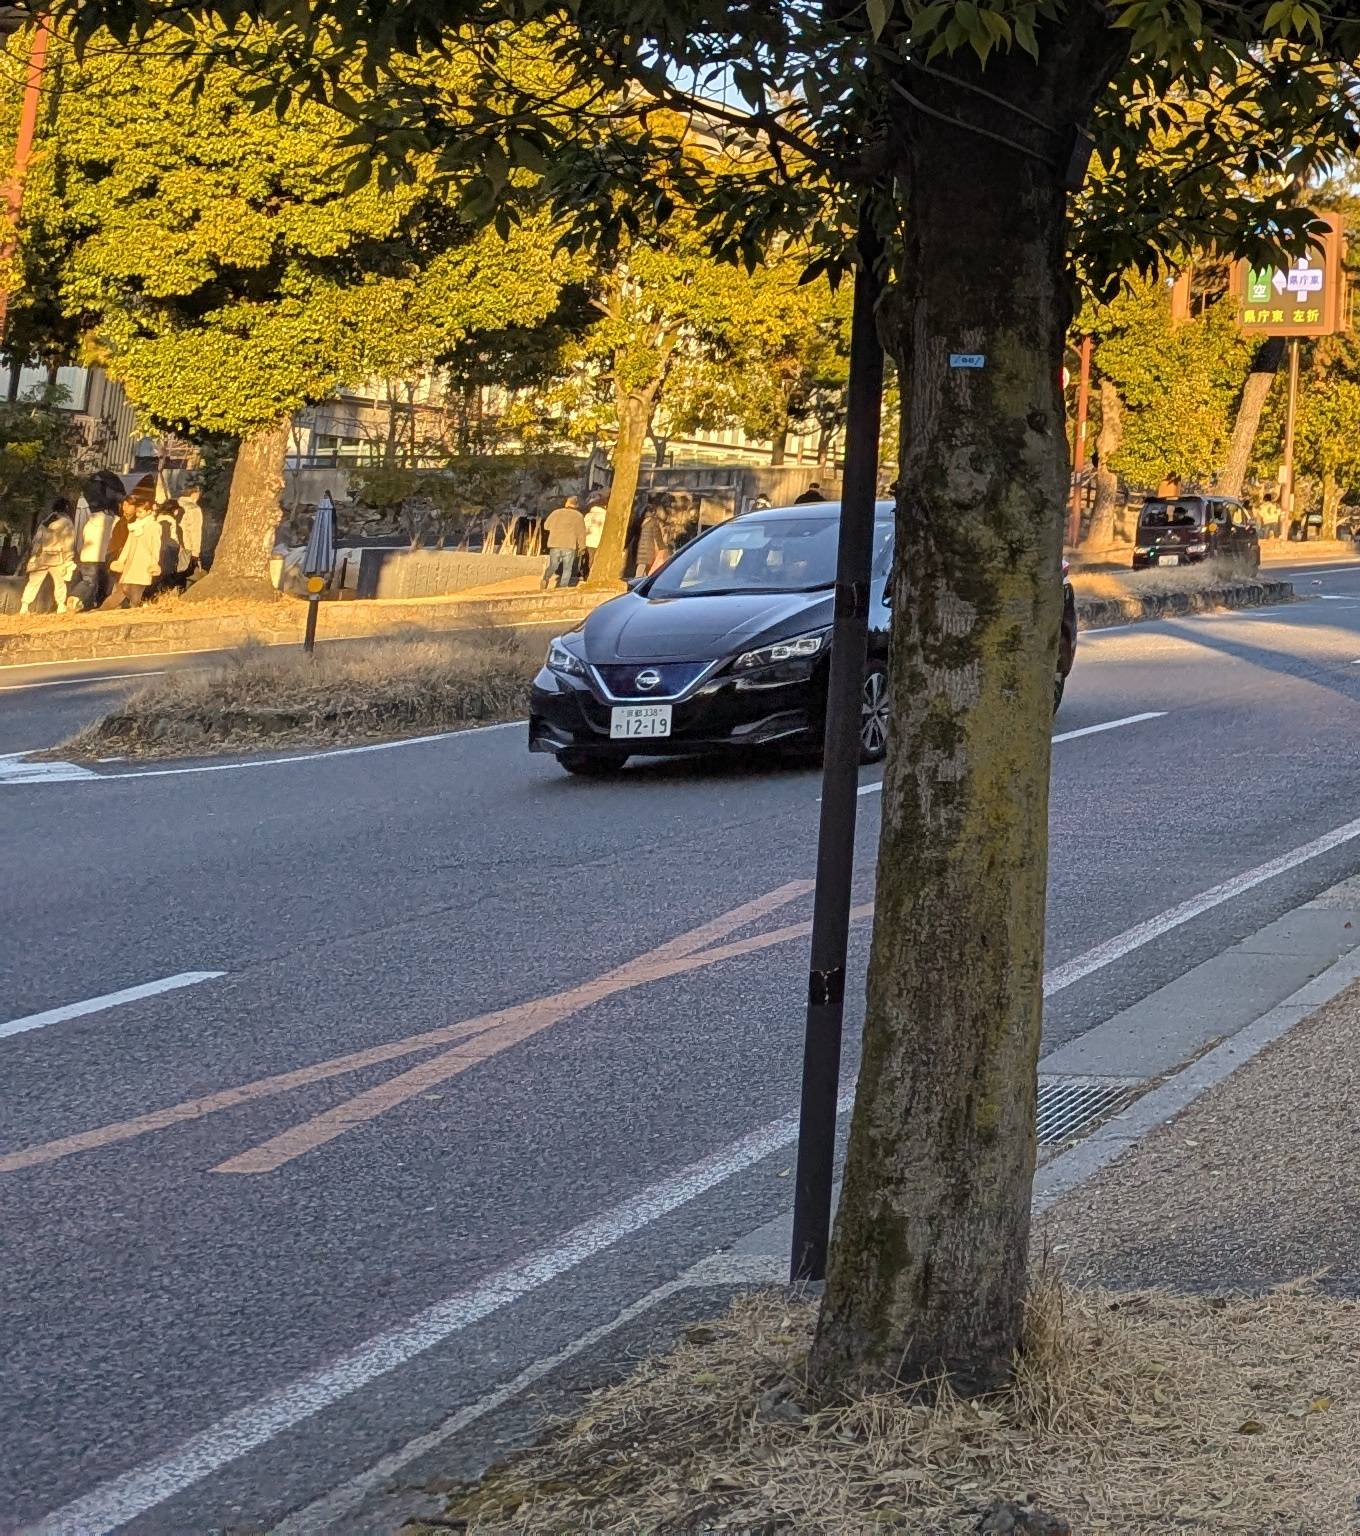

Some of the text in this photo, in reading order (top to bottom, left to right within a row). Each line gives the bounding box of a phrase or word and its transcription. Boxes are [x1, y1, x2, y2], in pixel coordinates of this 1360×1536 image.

[1252, 284, 1267, 299] 空
[1244, 309, 1320, 323] 県庁東 左折
[625, 718, 668, 735] 12-19
